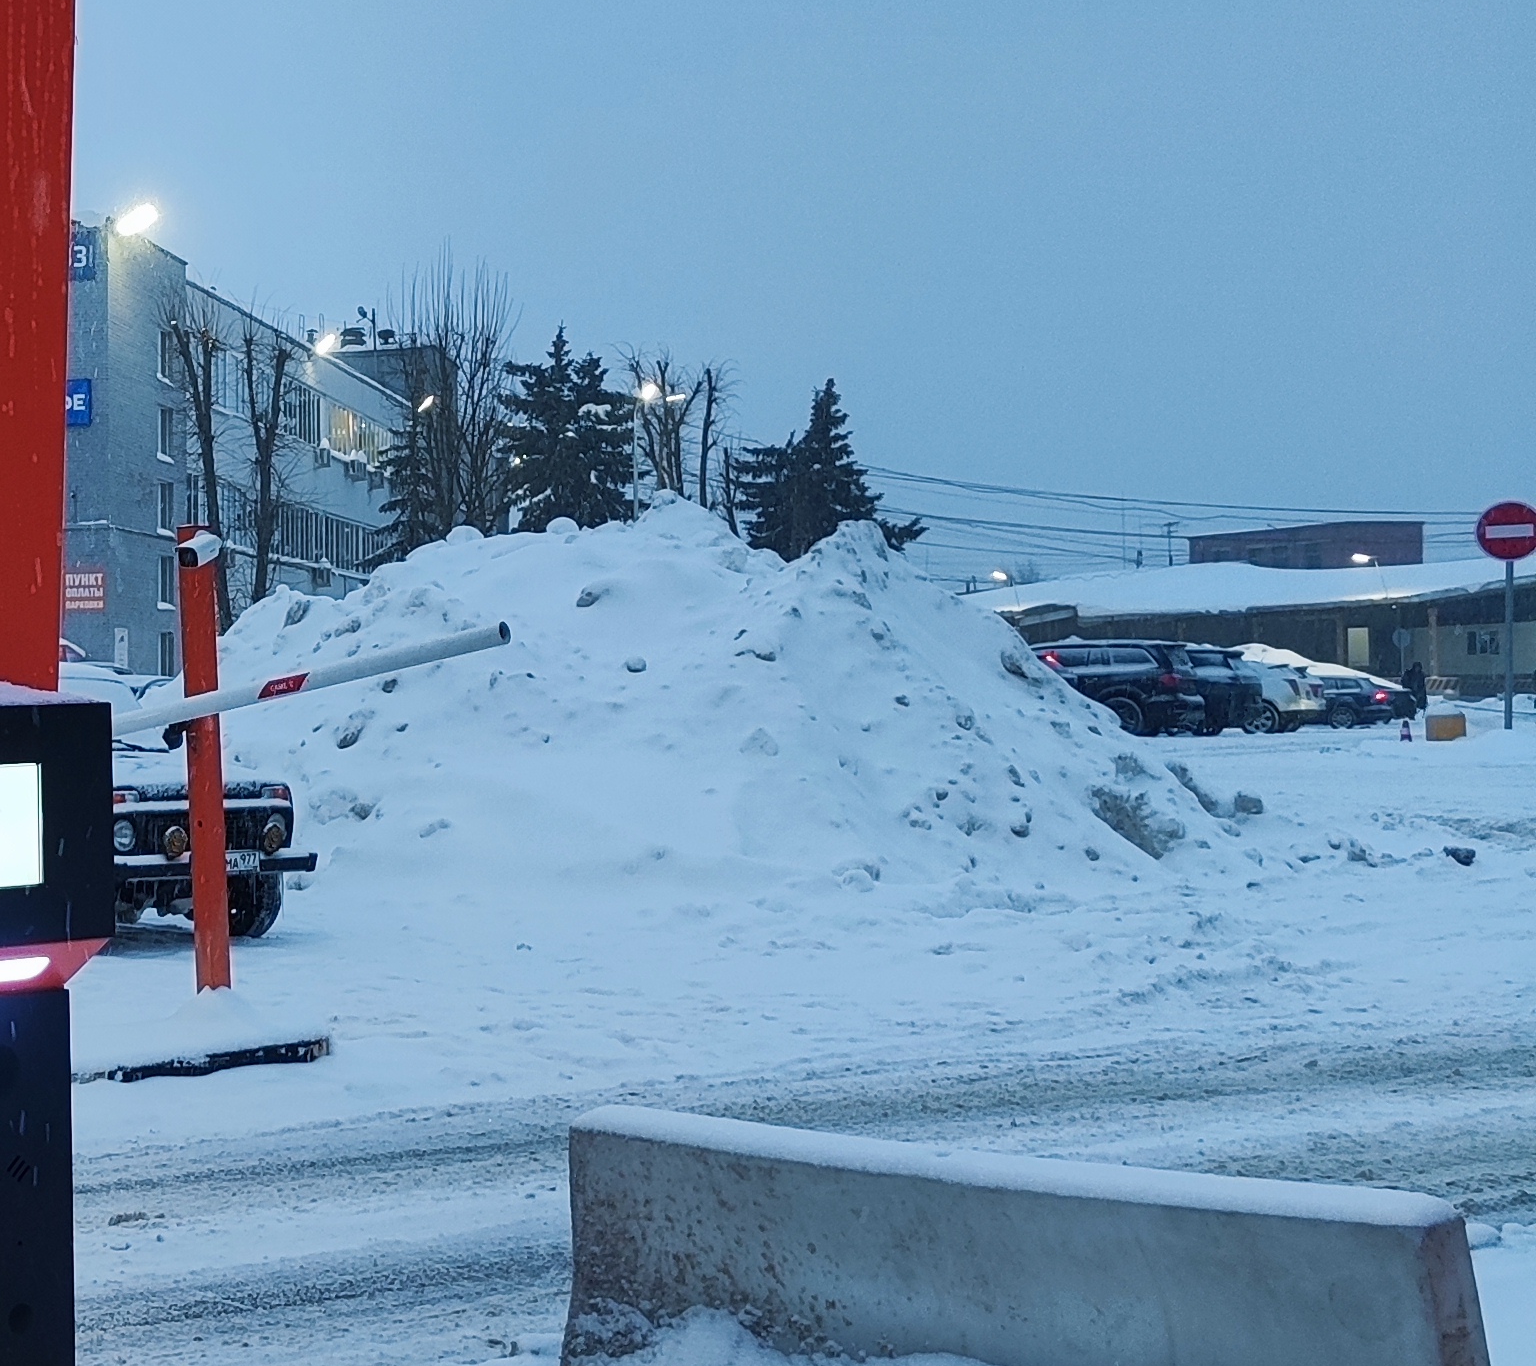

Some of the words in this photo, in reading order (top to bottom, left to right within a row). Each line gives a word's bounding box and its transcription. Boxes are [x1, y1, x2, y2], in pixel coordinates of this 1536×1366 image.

[65, 573, 104, 586] ПУНКТ
[65, 587, 104, 598] ОПЛАТЫ
[240, 852, 257, 865] 977
